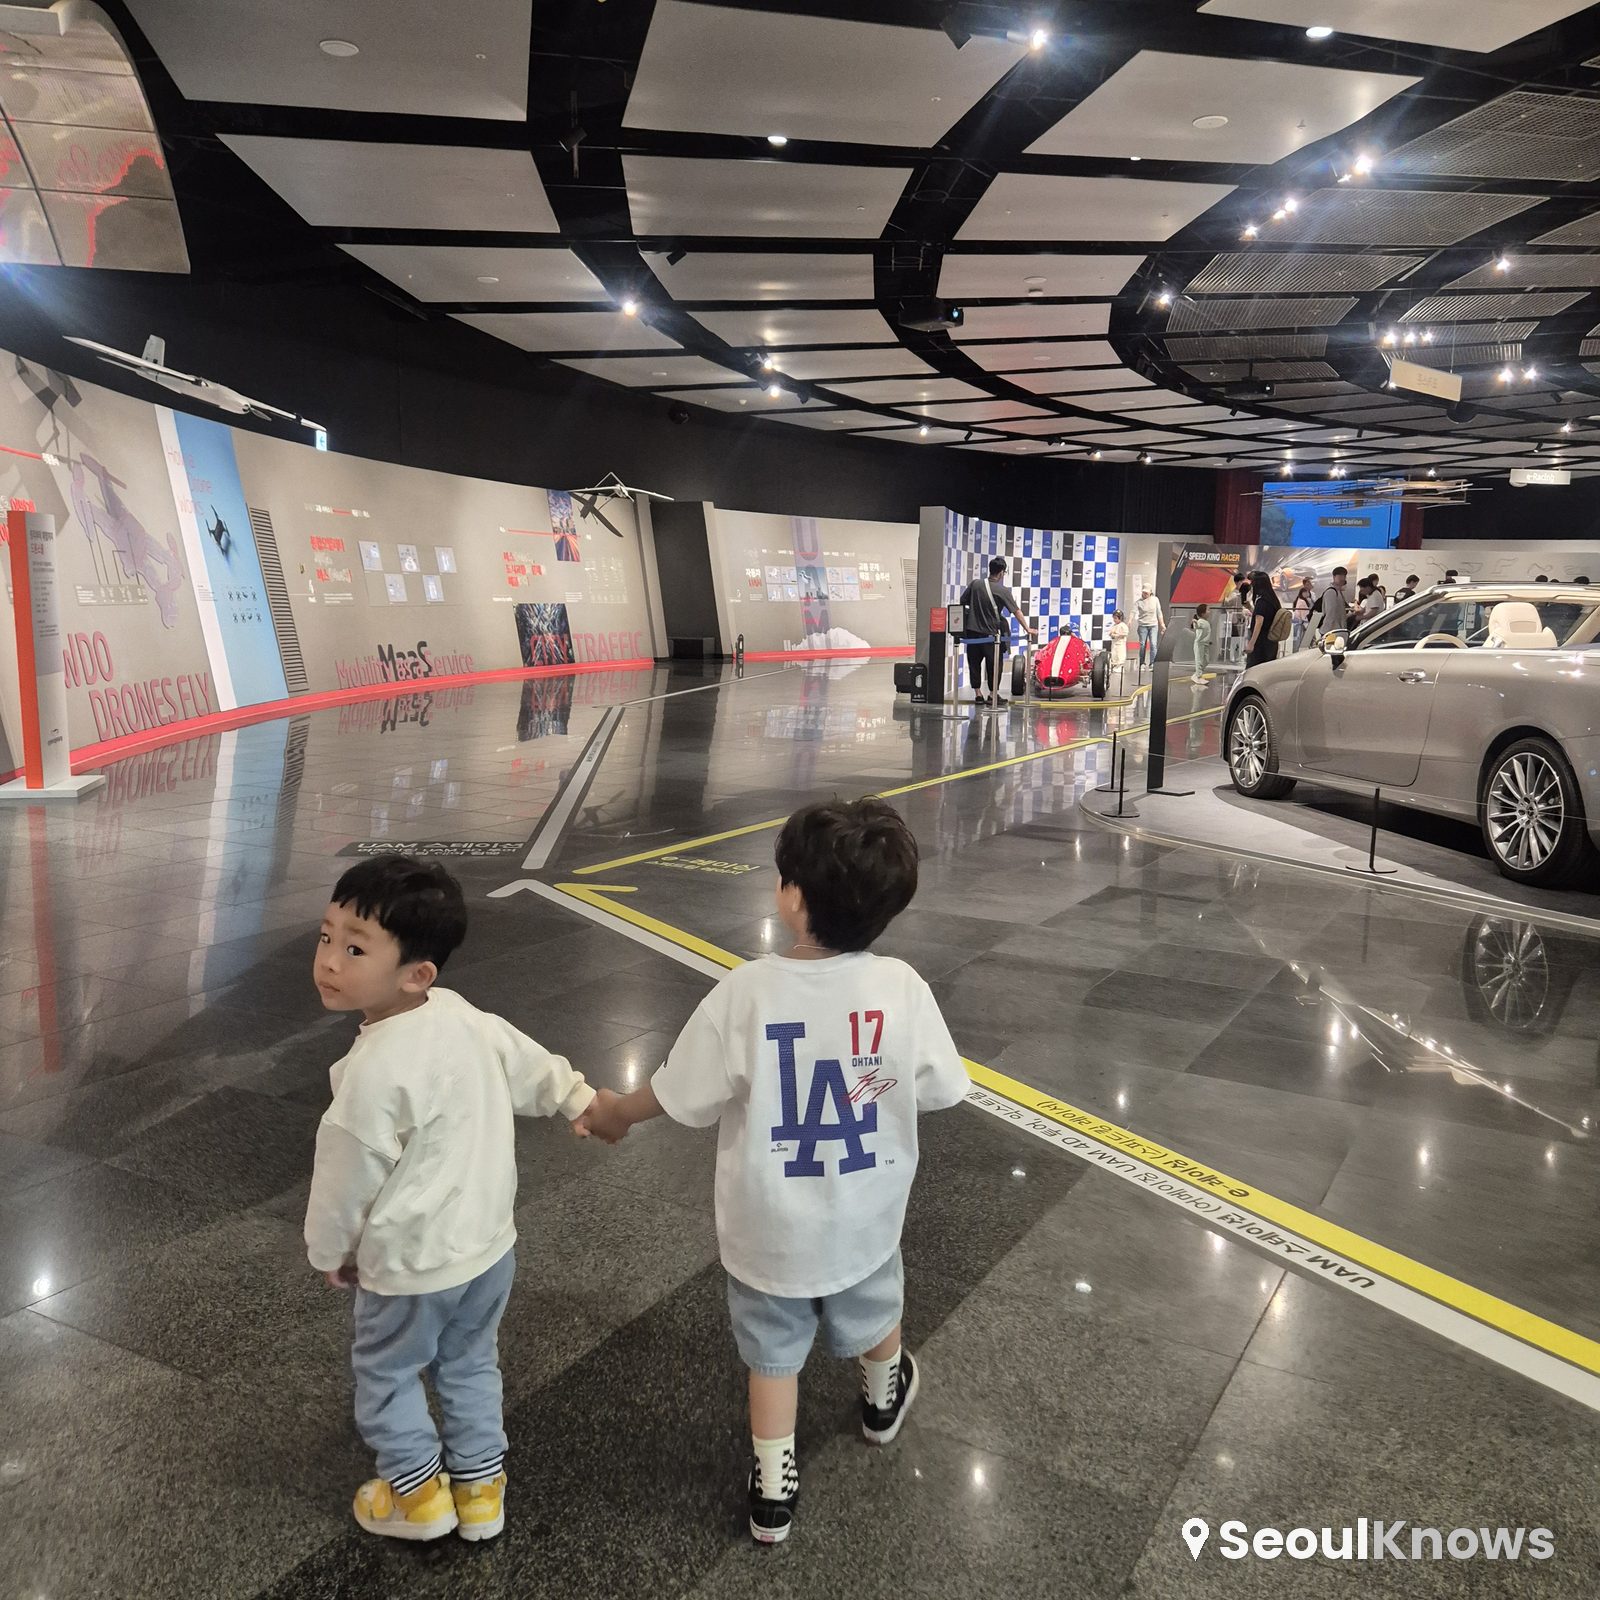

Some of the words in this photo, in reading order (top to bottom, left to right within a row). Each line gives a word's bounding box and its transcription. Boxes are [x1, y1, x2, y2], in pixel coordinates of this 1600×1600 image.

[1188, 552, 1207, 561] SPEED
[1206, 552, 1221, 562] KING
[1220, 553, 1240, 562] RACER
[572, 630, 646, 662] TRAFFIC
[88, 677, 179, 742] DRONES
[176, 672, 211, 720] FLY
[660, 856, 761, 871] e-레이싱
[849, 1010, 884, 1056] 17
[852, 1055, 883, 1068] OHTANI
[765, 1021, 878, 1178] LA
[966, 1091, 1024, 1120] 익스트림
[1036, 1100, 1092, 1126] 레이서)
[1061, 1136, 1091, 1149] 4D
[1088, 1124, 1167, 1160] (스피드킹
[1088, 1149, 1137, 1173] UAM
[1133, 1171, 1222, 1214] (어메이징
[1163, 1159, 1250, 1198] e-레이싱
[1217, 1212, 1311, 1255] 스테이션
[1306, 1255, 1376, 1289] UAM
